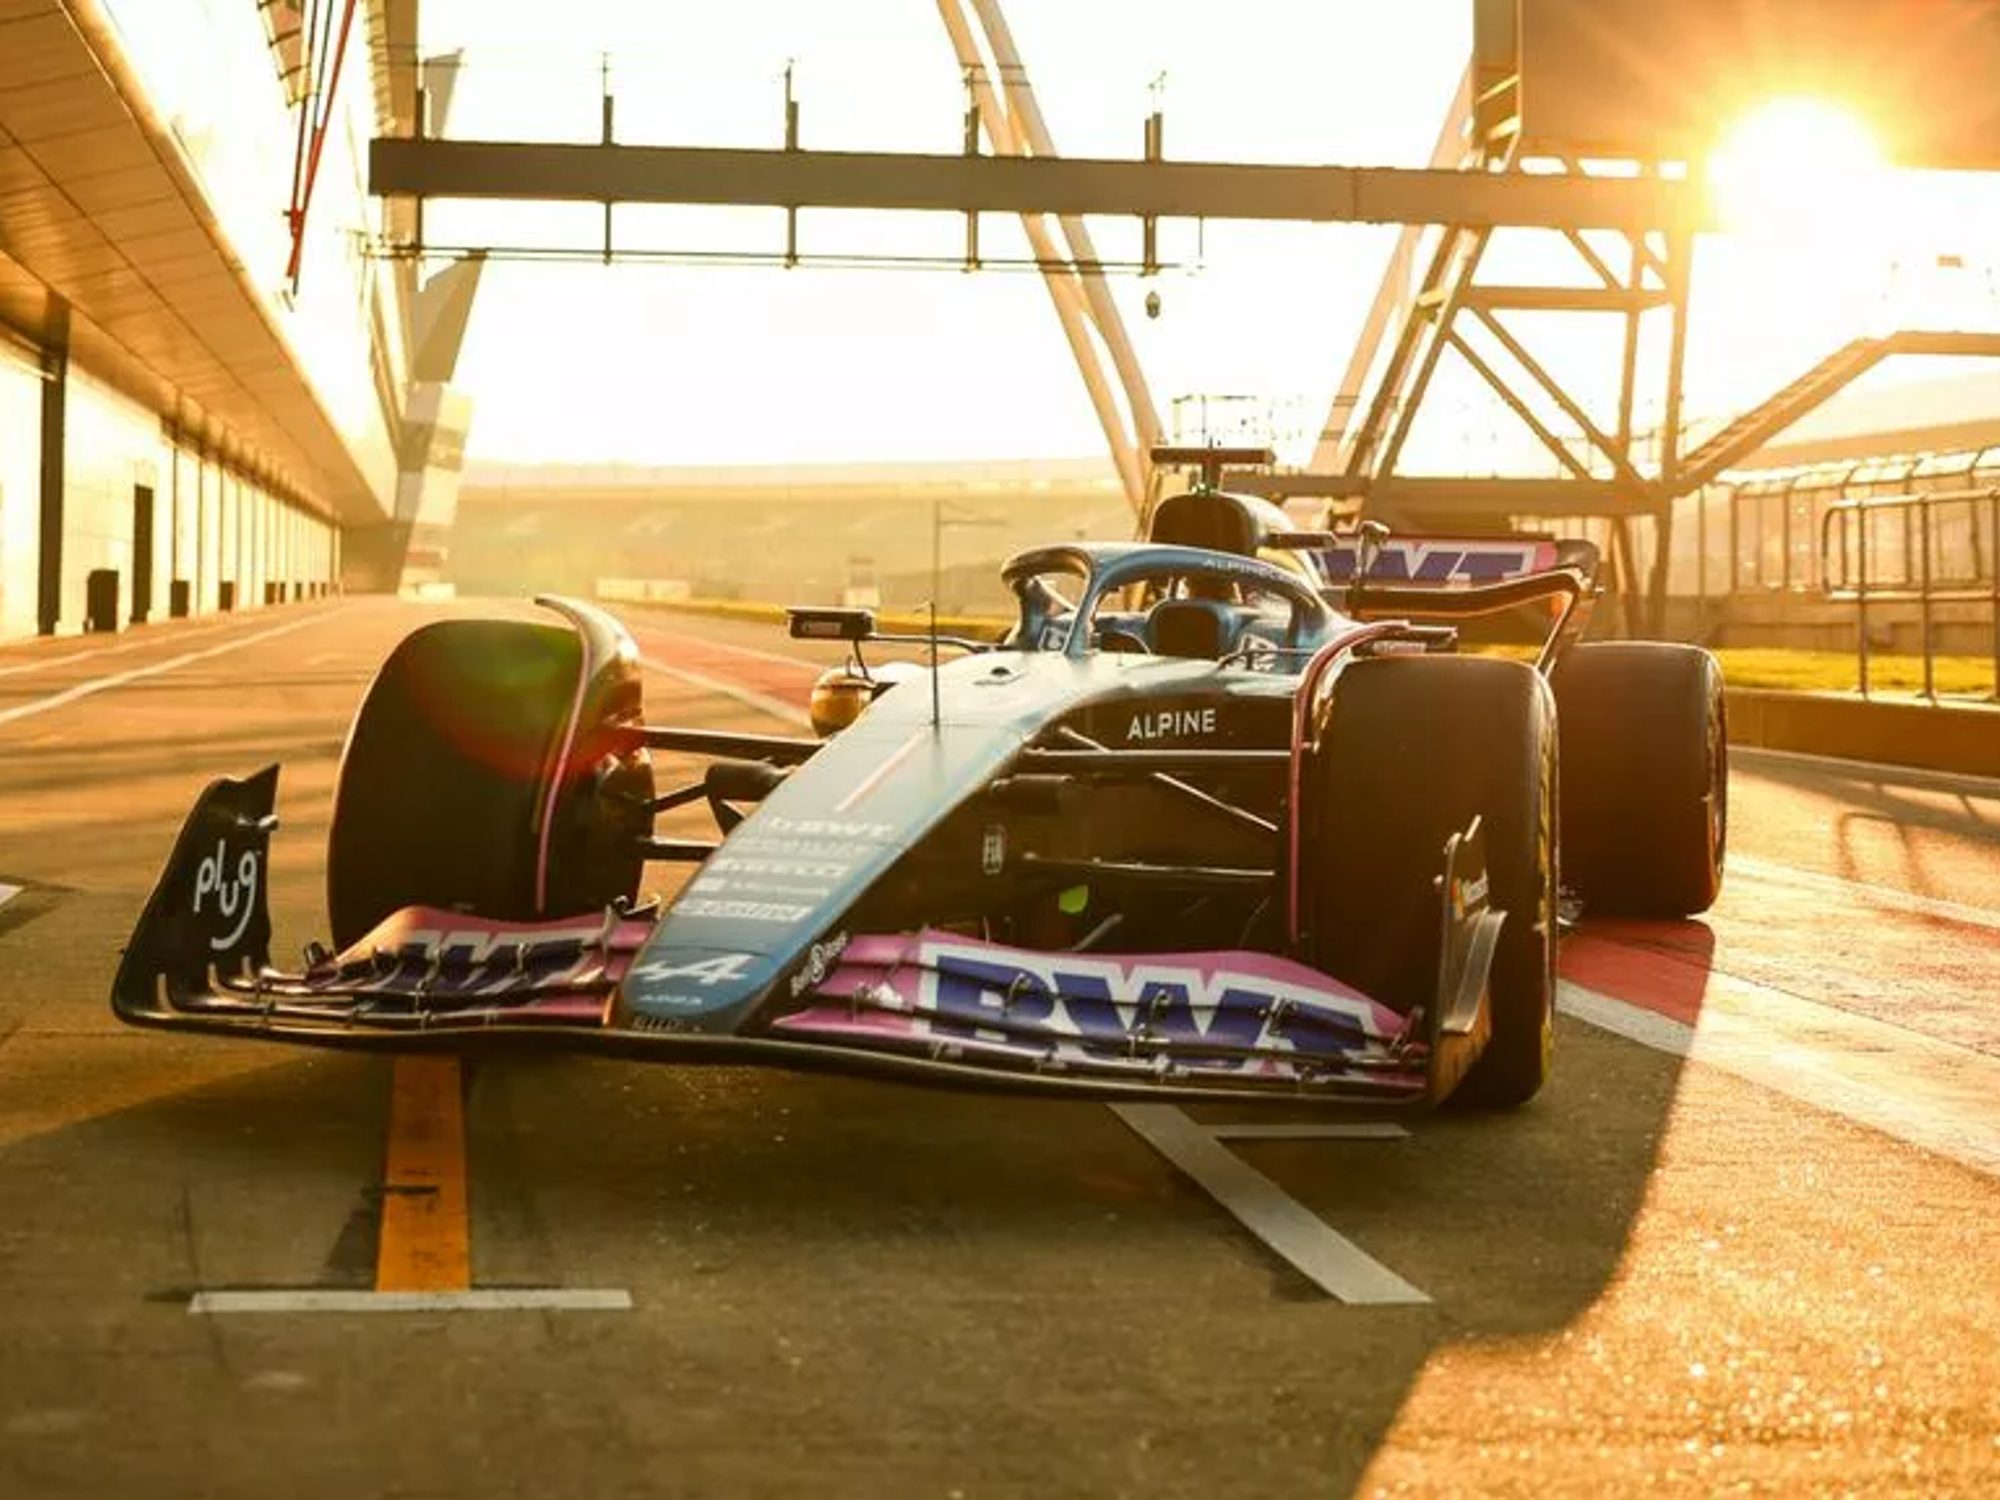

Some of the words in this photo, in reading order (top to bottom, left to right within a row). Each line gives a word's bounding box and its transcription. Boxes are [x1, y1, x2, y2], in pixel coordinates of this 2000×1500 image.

[1313, 548, 1525, 586] WT
[1127, 709, 1216, 741] ALPINE
[195, 839, 258, 950] plug
[922, 955, 1374, 1072] BWT
